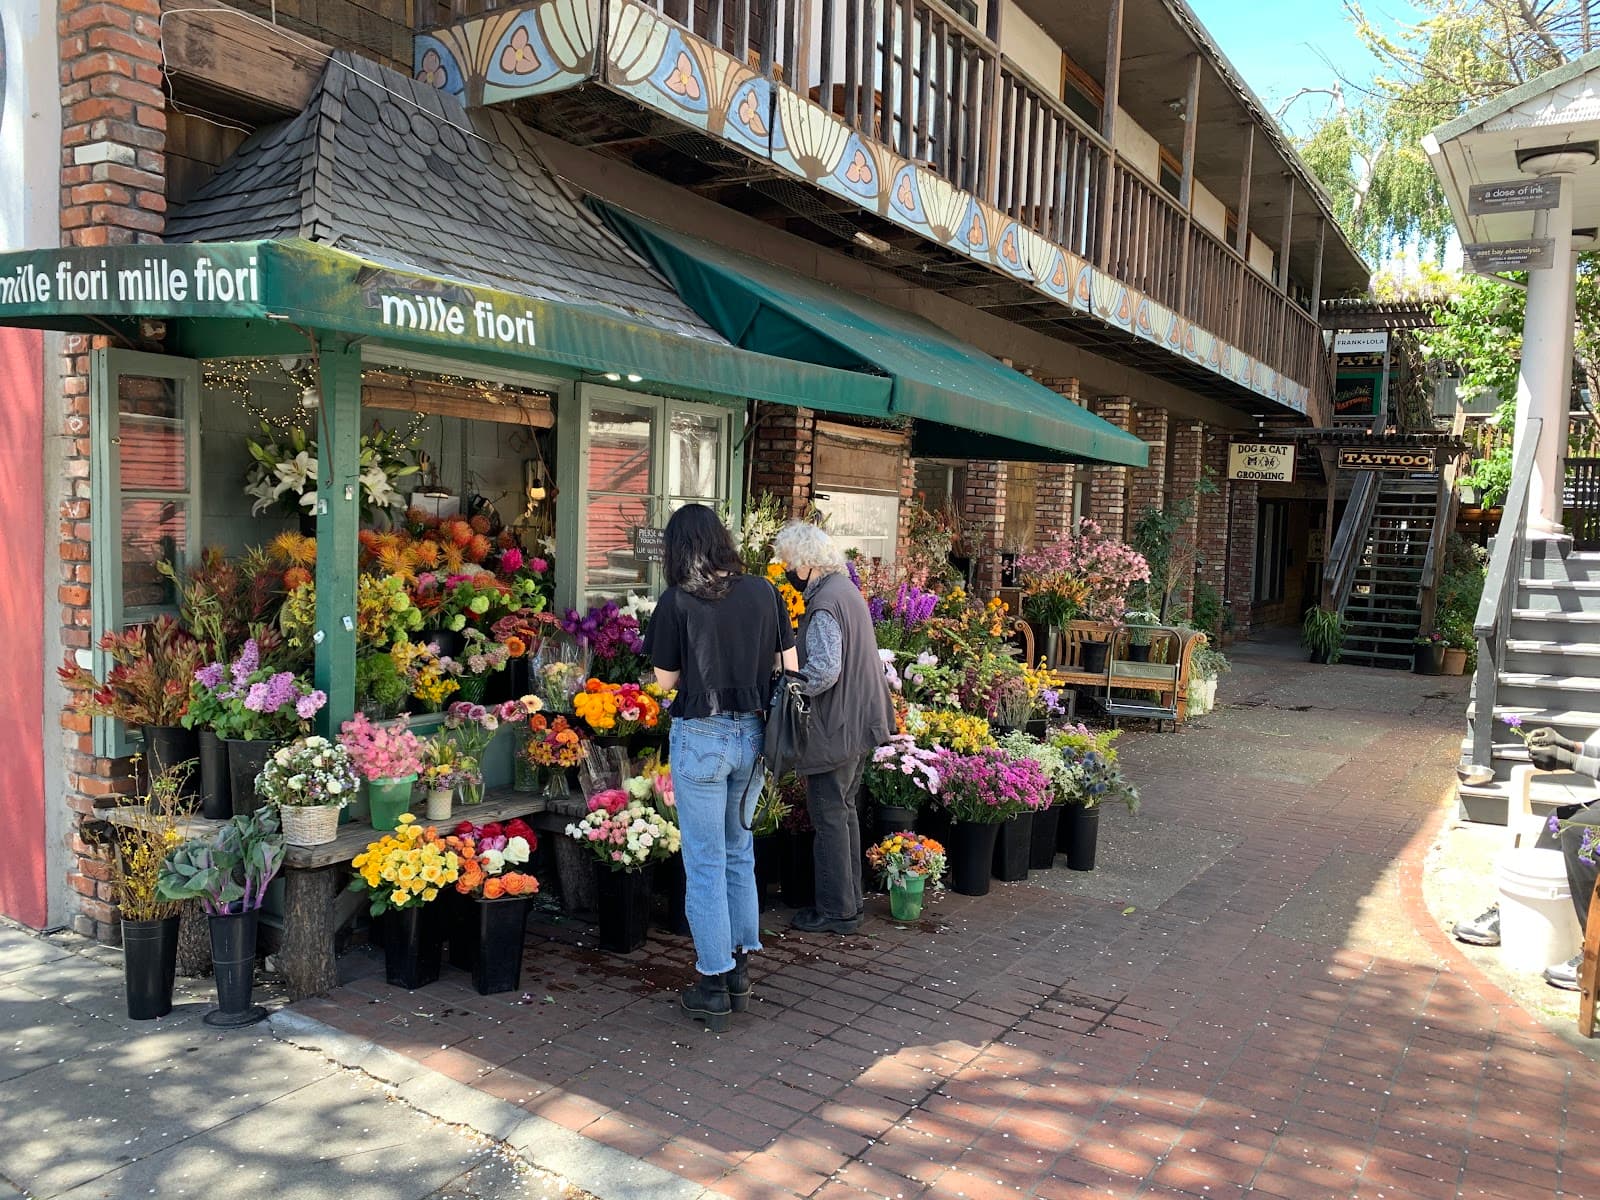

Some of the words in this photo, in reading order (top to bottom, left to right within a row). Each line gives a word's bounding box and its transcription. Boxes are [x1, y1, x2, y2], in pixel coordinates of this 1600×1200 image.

[1493, 189, 1515, 198] dose
[1518, 186, 1528, 195] of
[1530, 185, 1543, 194] ink
[1506, 247, 1540, 255] electrolysis
[56, 260, 108, 301] fiori
[118, 258, 188, 301] mille
[194, 257, 259, 301] fiori
[381, 295, 465, 335] mille
[473, 301, 536, 346] fiori
[1238, 445, 1257, 454] DOG
[1269, 446, 1288, 455] CAT
[1344, 453, 1429, 465] TATTOO
[1236, 471, 1285, 480] GROOMING
